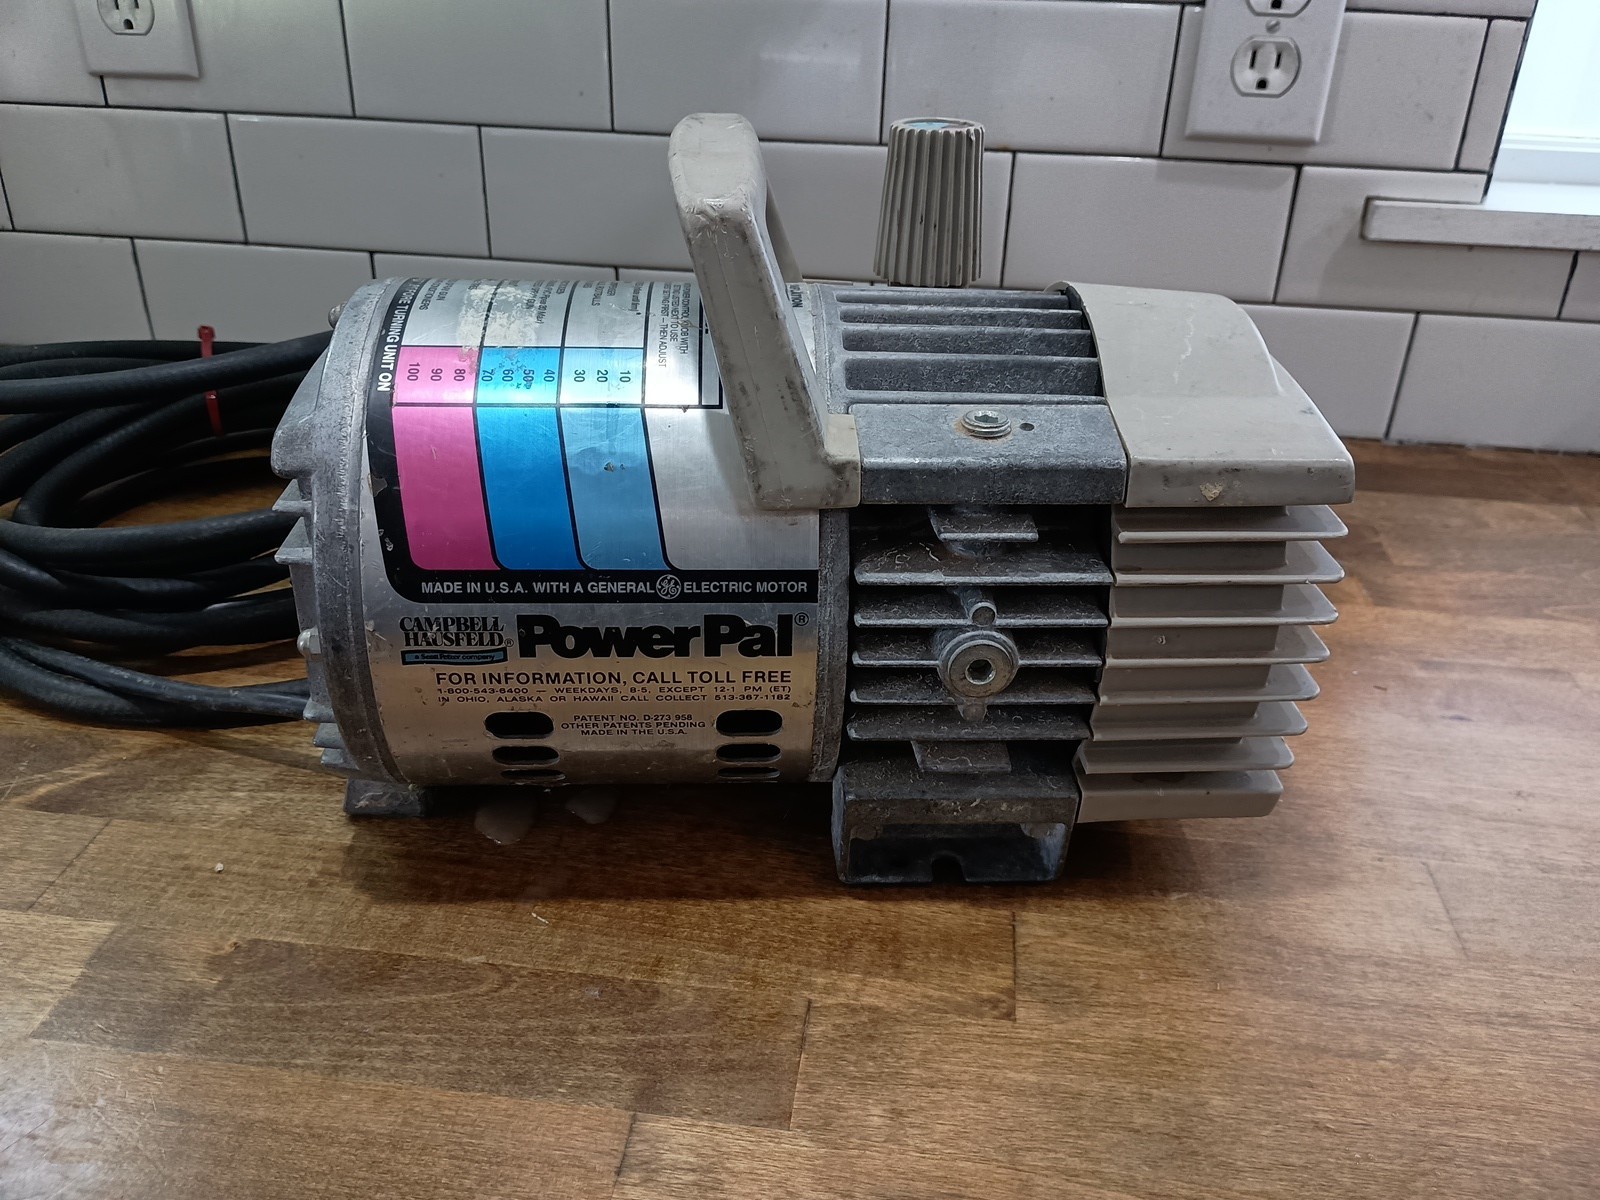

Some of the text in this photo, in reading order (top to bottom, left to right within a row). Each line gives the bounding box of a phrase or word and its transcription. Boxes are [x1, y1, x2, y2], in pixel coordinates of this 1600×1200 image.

[386, 309, 409, 343] TURNING
[658, 323, 669, 340] THEN
[670, 321, 679, 329] TO
[669, 329, 678, 342] USE
[679, 338, 690, 355] WITH
[380, 344, 398, 371] UNIT
[658, 340, 667, 368] ADJUST
[406, 362, 421, 382] 100
[430, 368, 443, 382] 90
[453, 368, 466, 382] 80
[481, 368, 494, 382] 70
[501, 368, 514, 382] 60
[522, 368, 535, 383] 50
[543, 368, 556, 383] 40
[573, 369, 586, 383] 30
[596, 369, 609, 383] 20
[619, 369, 632, 383] 10
[376, 372, 393, 393] ON
[421, 581, 463, 594] MADE
[466, 581, 481, 594] IN
[485, 581, 529, 594] U.S.A.
[532, 581, 570, 594] WITH
[573, 581, 584, 594] A
[587, 581, 655, 594] GENERAL
[683, 581, 752, 593] ELECTRIC
[756, 581, 808, 593] MOTOR
[399, 616, 505, 632] CAMPBELL
[436, 670, 792, 686] FOR INFORMATION, CALL TOLL FREE
[744, 685, 763, 693] PM
[769, 685, 791, 694] (ET)
[655, 694, 708, 702] COLLECT
